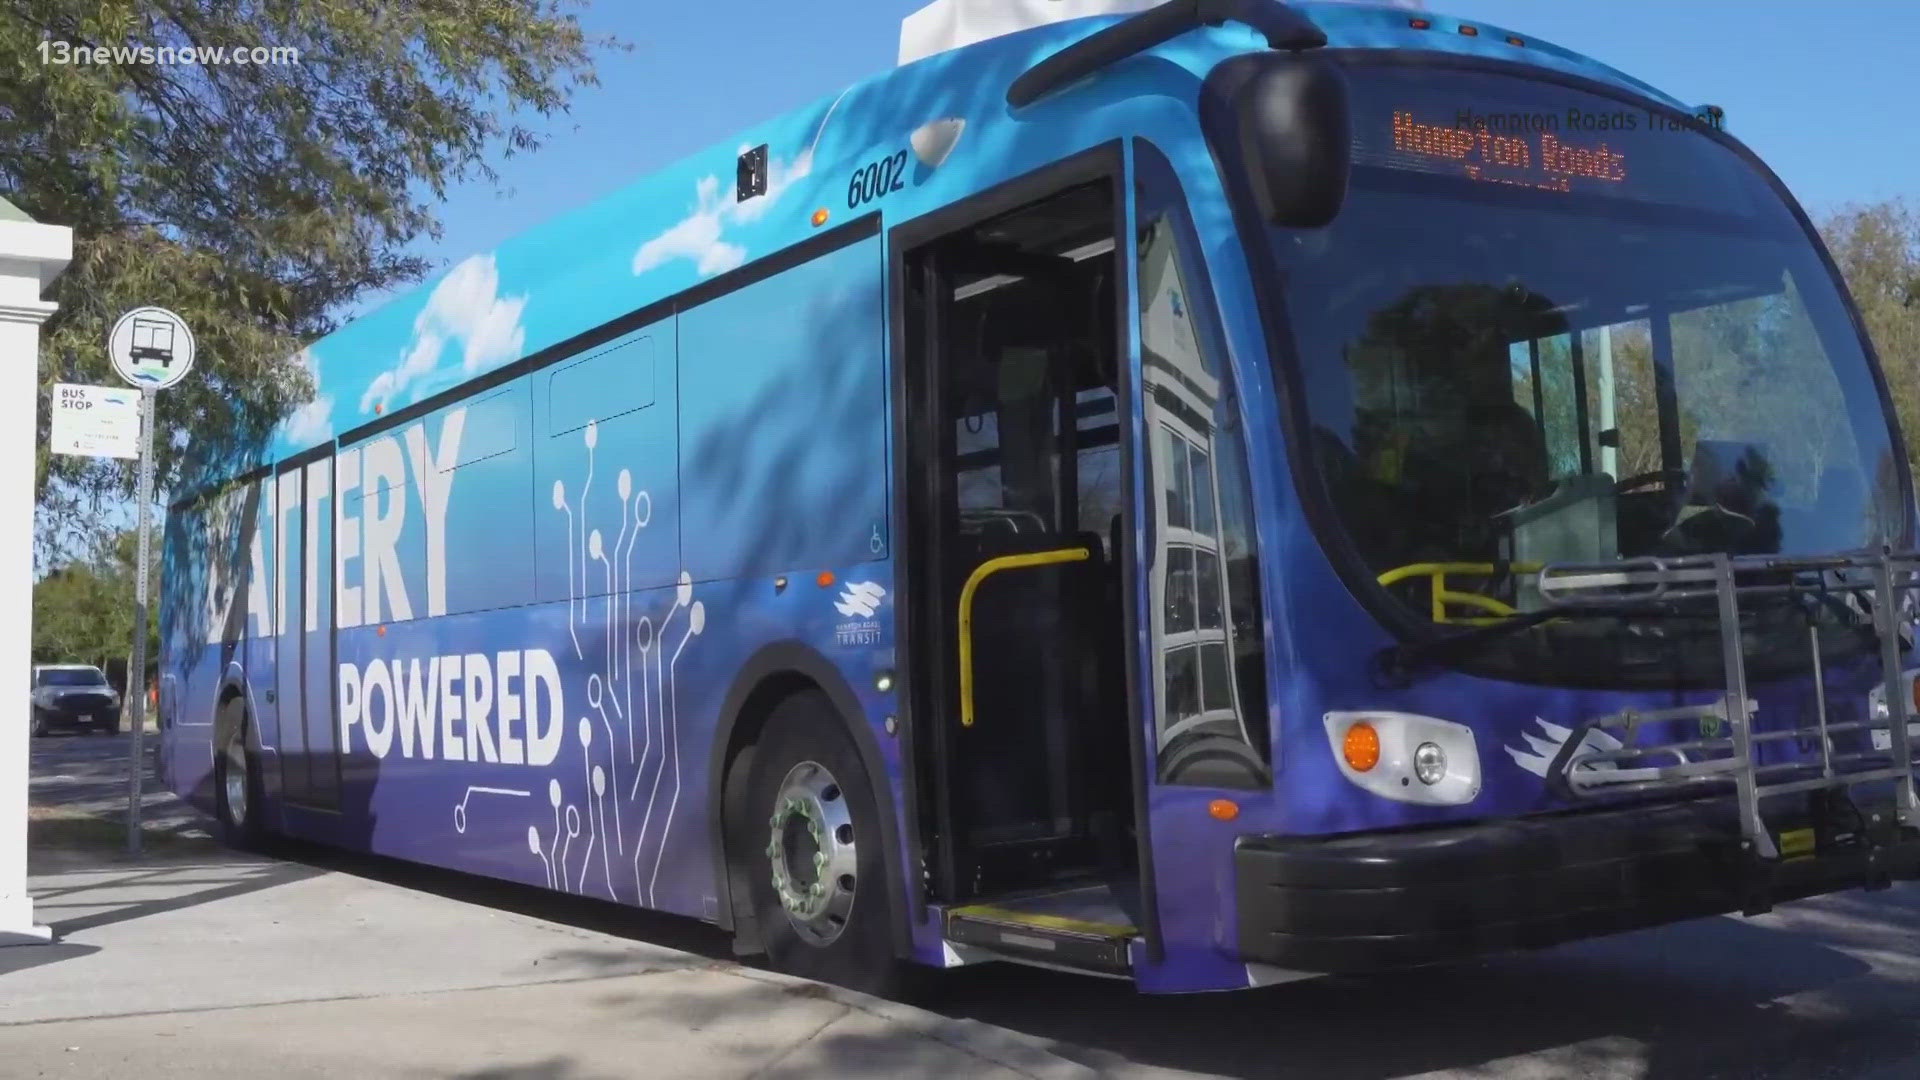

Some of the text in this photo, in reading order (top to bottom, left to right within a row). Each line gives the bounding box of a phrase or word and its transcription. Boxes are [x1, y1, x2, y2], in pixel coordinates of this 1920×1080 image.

[848, 149, 907, 209] 6002
[62, 389, 85, 398] BUS
[62, 400, 93, 410] STOP
[73, 440, 79, 449] 4
[836, 631, 881, 645] TRANSIT
[338, 648, 564, 767] POWERED
